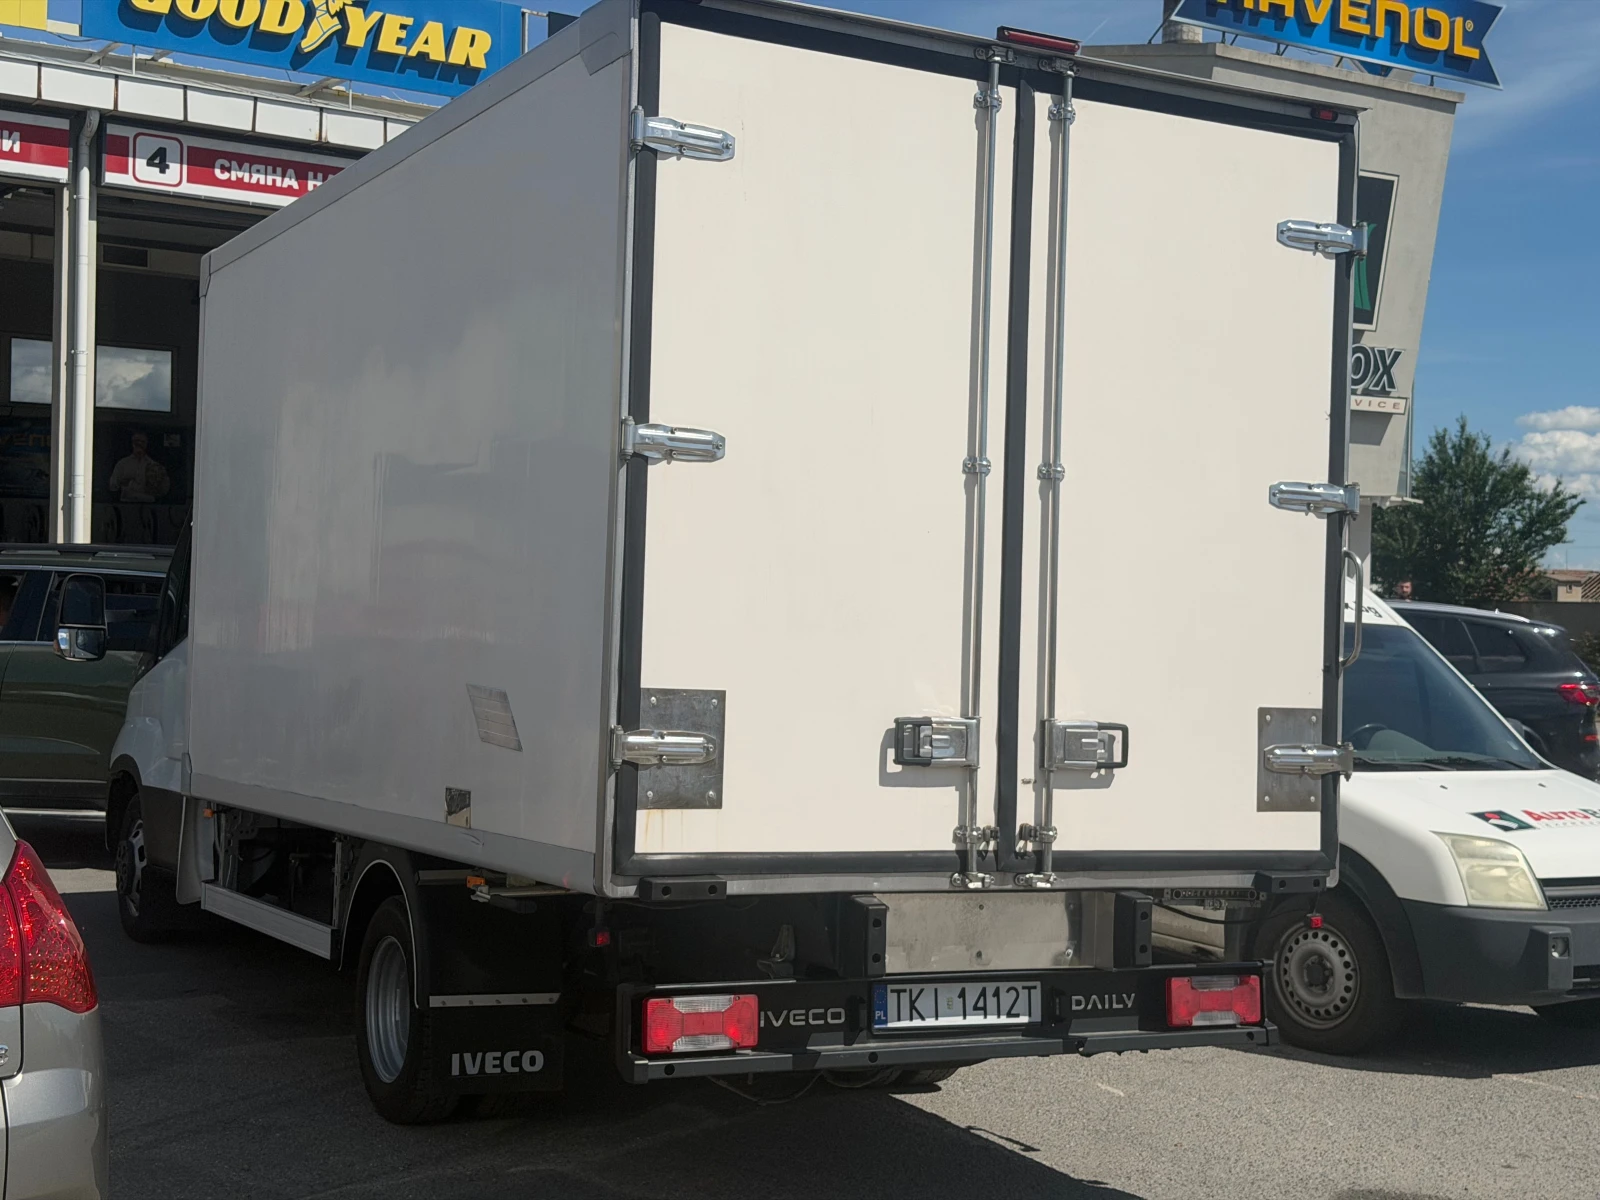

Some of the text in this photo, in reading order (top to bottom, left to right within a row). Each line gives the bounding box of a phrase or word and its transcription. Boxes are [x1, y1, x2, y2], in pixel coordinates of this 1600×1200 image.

[1216, 0, 1480, 59] VENOL
[146, 147, 170, 174] 4
[214, 159, 334, 192] СМЯНА Н
[875, 1010, 886, 1021] PL
[890, 985, 1037, 1022] TKI 1412T
[1071, 993, 1136, 1011] DAILY
[760, 1007, 846, 1028] IVECO
[451, 1049, 545, 1076] IVECO
